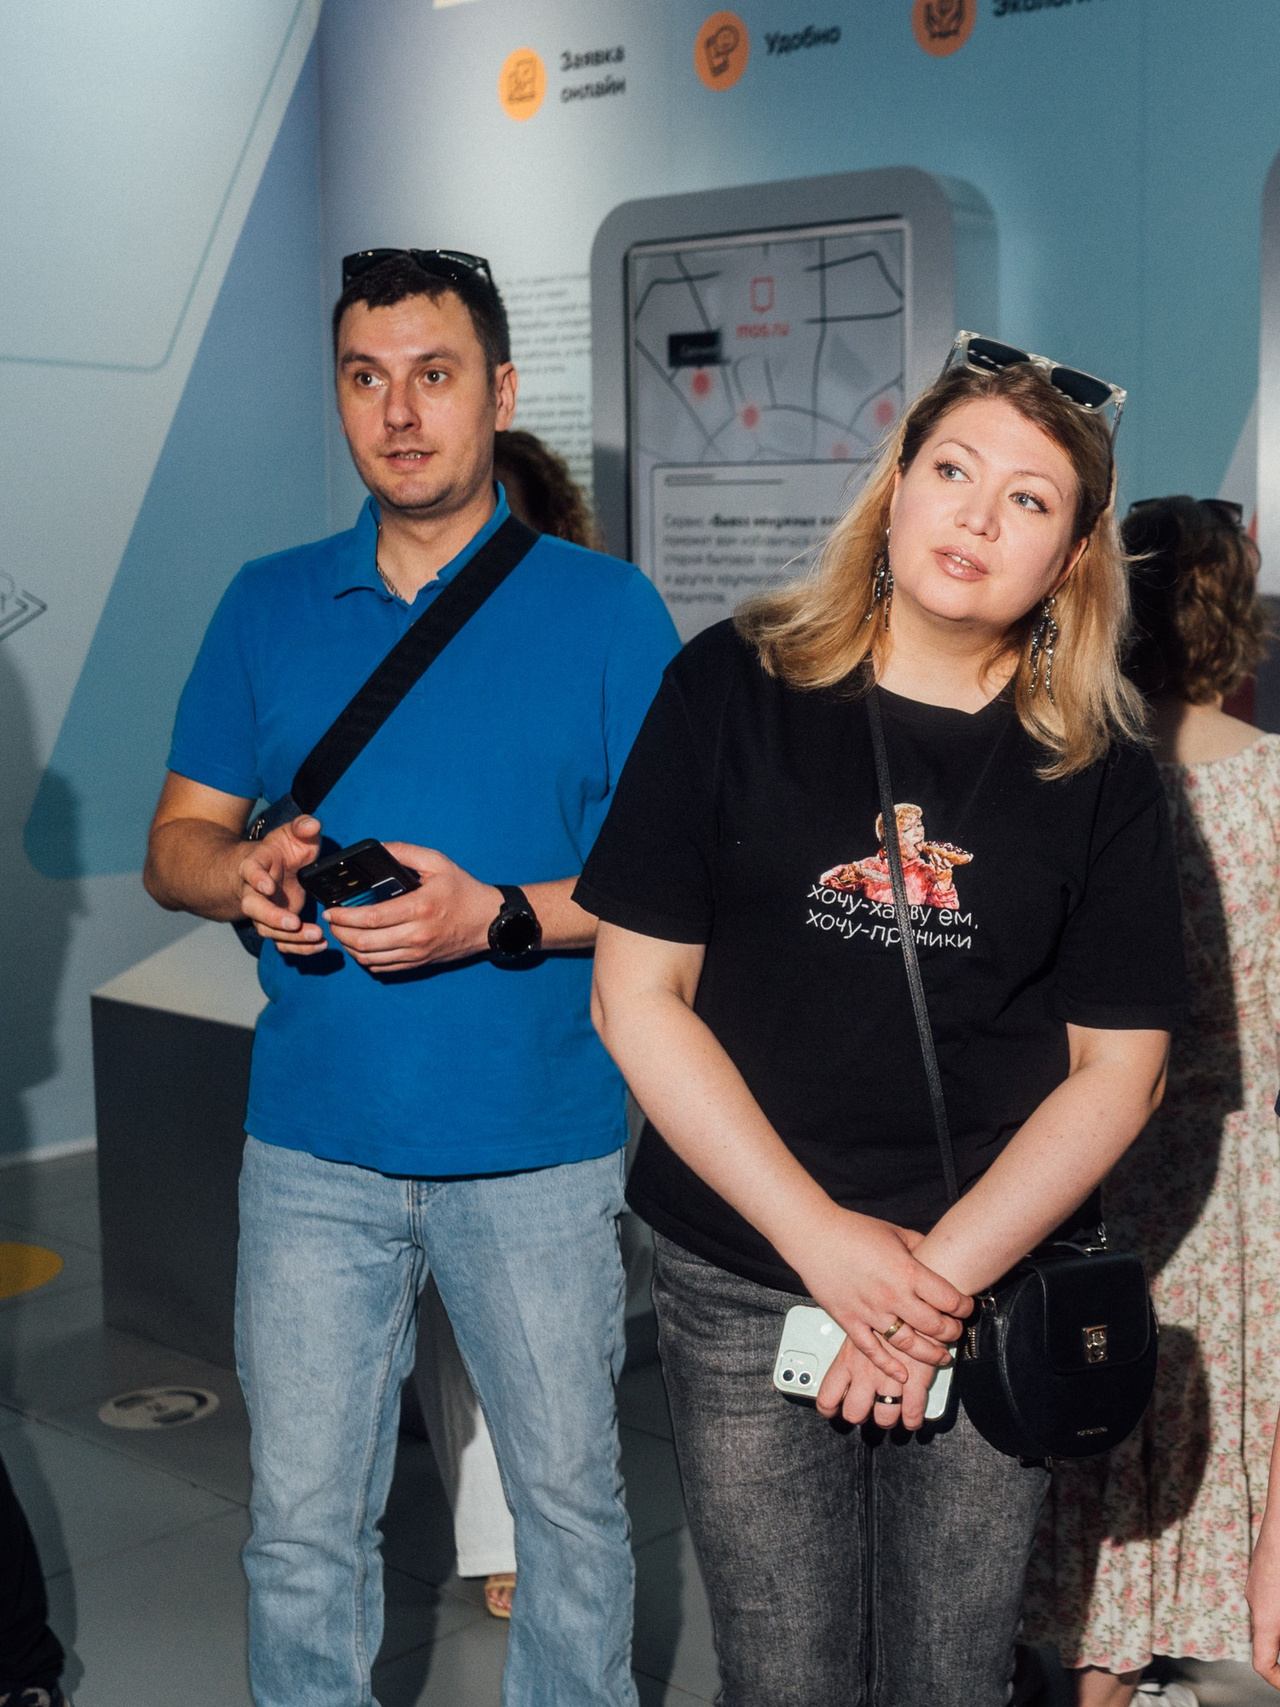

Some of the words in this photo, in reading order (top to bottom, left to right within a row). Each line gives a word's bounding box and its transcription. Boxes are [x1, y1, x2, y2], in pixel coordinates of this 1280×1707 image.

[764, 24, 841, 56] Удобно
[560, 46, 625, 72] Заявка
[560, 75, 626, 103] онлайн
[807, 884, 932, 926] хочу-хаву
[805, 909, 972, 949] хочу-прники
